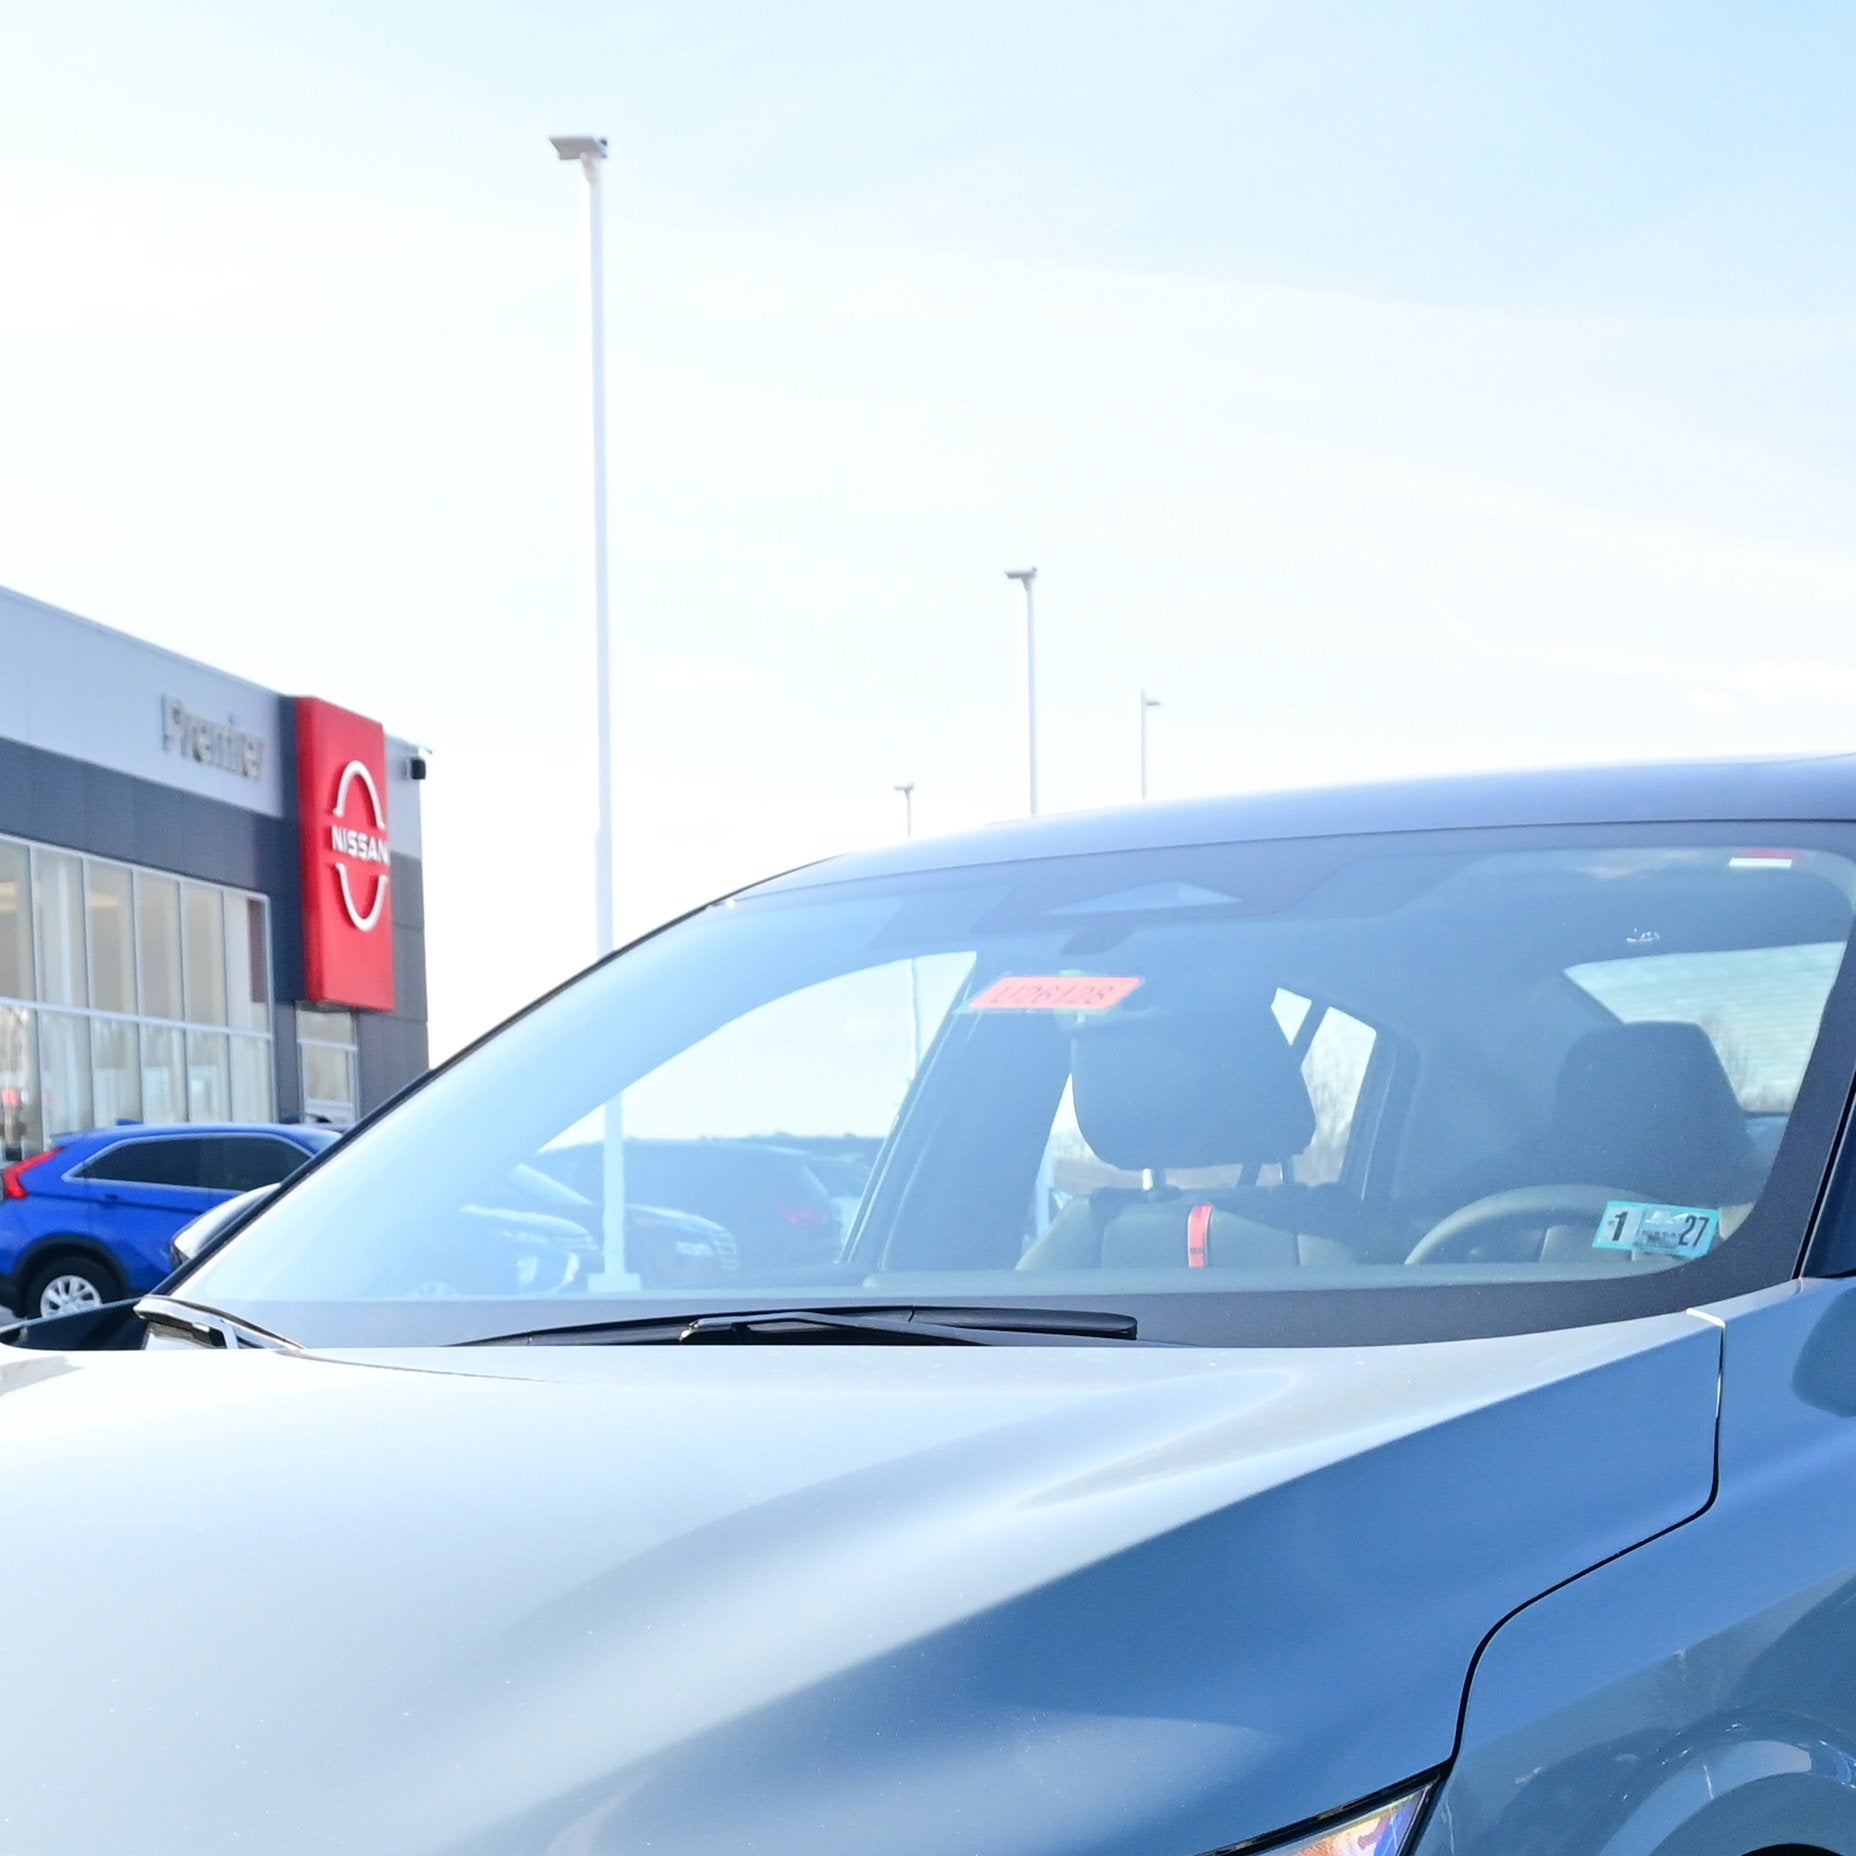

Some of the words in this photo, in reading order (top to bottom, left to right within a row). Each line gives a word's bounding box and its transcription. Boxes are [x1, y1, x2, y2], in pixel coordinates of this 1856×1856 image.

[160, 692, 265, 781] Premier
[331, 824, 391, 866] NISSAN
[1678, 1214, 1711, 1248] 27
